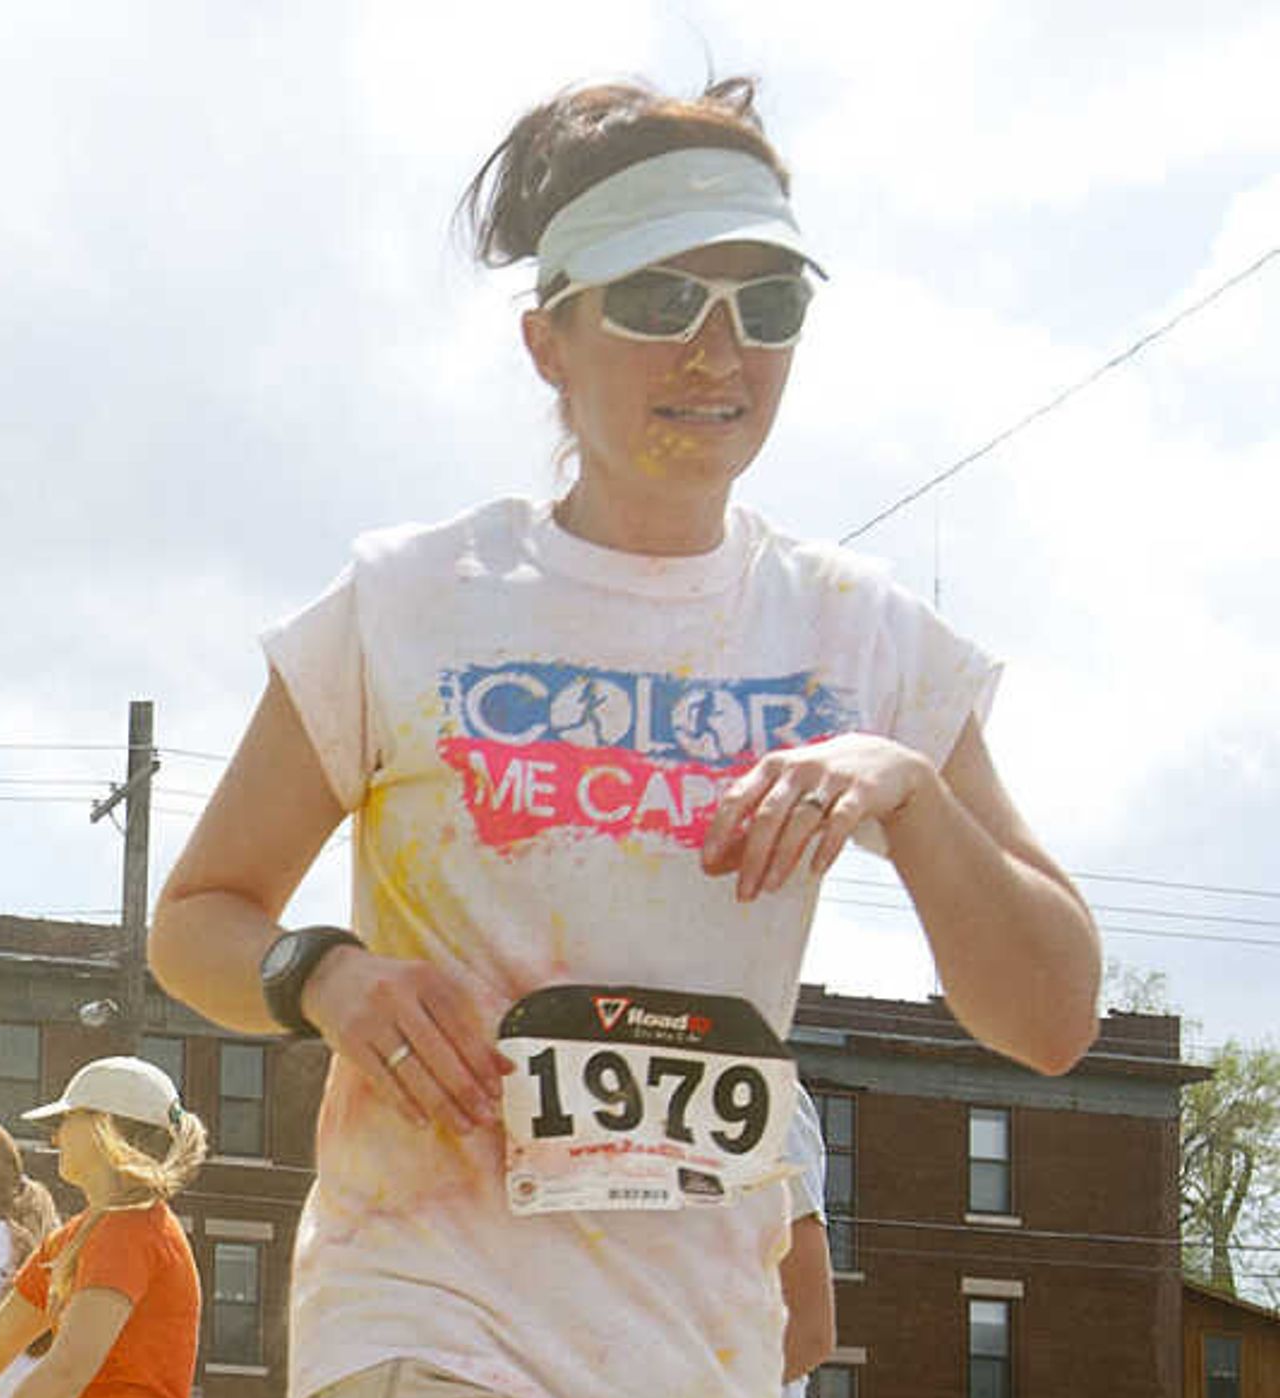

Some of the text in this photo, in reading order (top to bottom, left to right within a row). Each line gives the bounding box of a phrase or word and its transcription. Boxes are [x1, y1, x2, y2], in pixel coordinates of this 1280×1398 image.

[464, 671, 814, 762] COLOR
[469, 750, 737, 828] ME CAP
[529, 1047, 770, 1155] 1979
